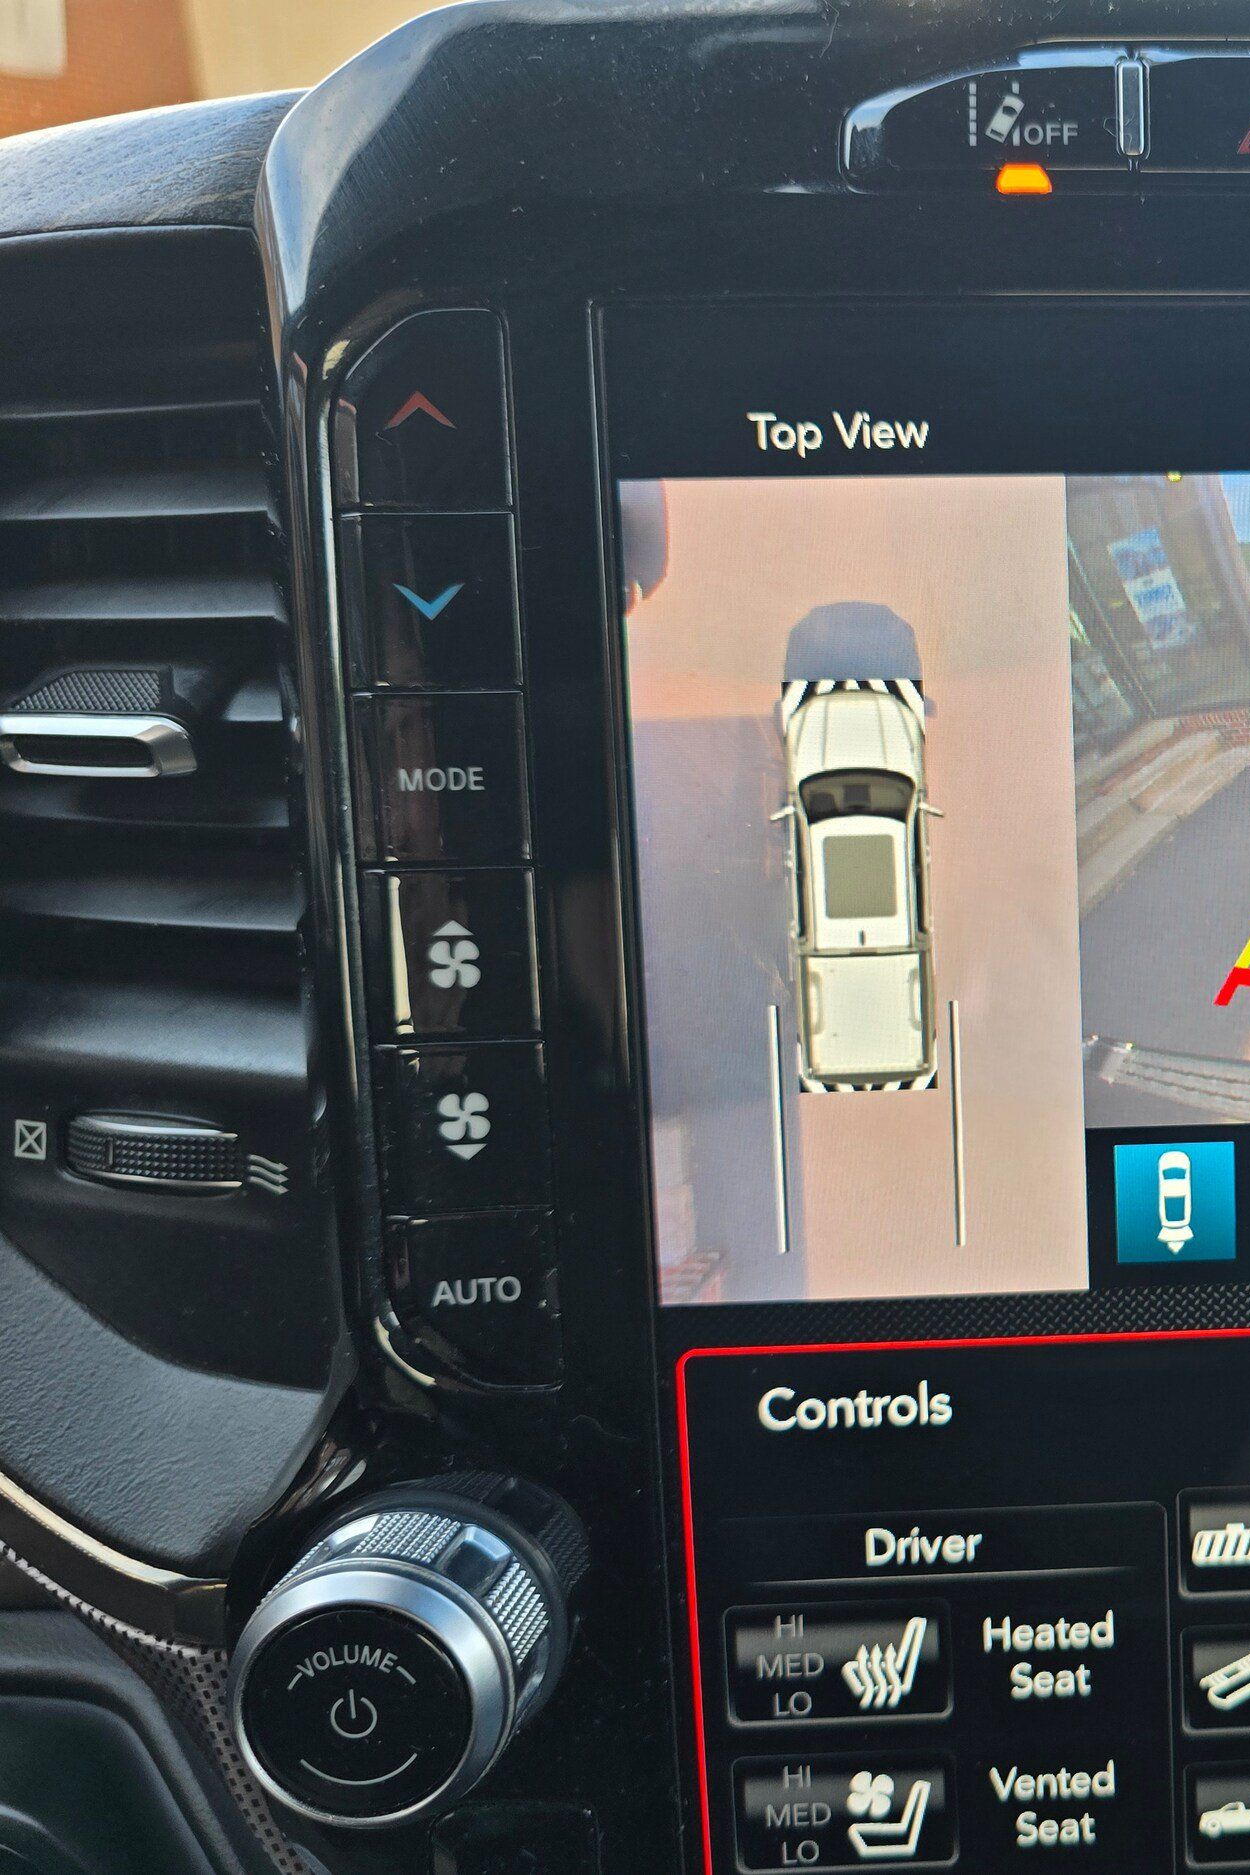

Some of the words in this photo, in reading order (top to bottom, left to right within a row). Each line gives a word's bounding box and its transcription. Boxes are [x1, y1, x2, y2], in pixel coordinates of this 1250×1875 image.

[1023, 122, 1078, 146] OFF
[747, 412, 823, 458] Top
[832, 411, 930, 450] View
[398, 766, 485, 792] MODE
[432, 1275, 522, 1307] AUTO
[757, 1379, 953, 1431] Controls
[865, 1526, 983, 1566] Driver
[775, 1614, 804, 1639] HI
[982, 1609, 1115, 1653] Heated
[296, 1643, 399, 1680] VOLUME
[756, 1651, 825, 1680] MED
[1010, 1661, 1092, 1699] Seat
[773, 1692, 813, 1719] LO
[782, 1765, 811, 1790] HI
[989, 1759, 1116, 1802] Vented
[764, 1801, 832, 1828] MED
[1015, 1810, 1096, 1847] Seat
[781, 1840, 820, 1866] LO
